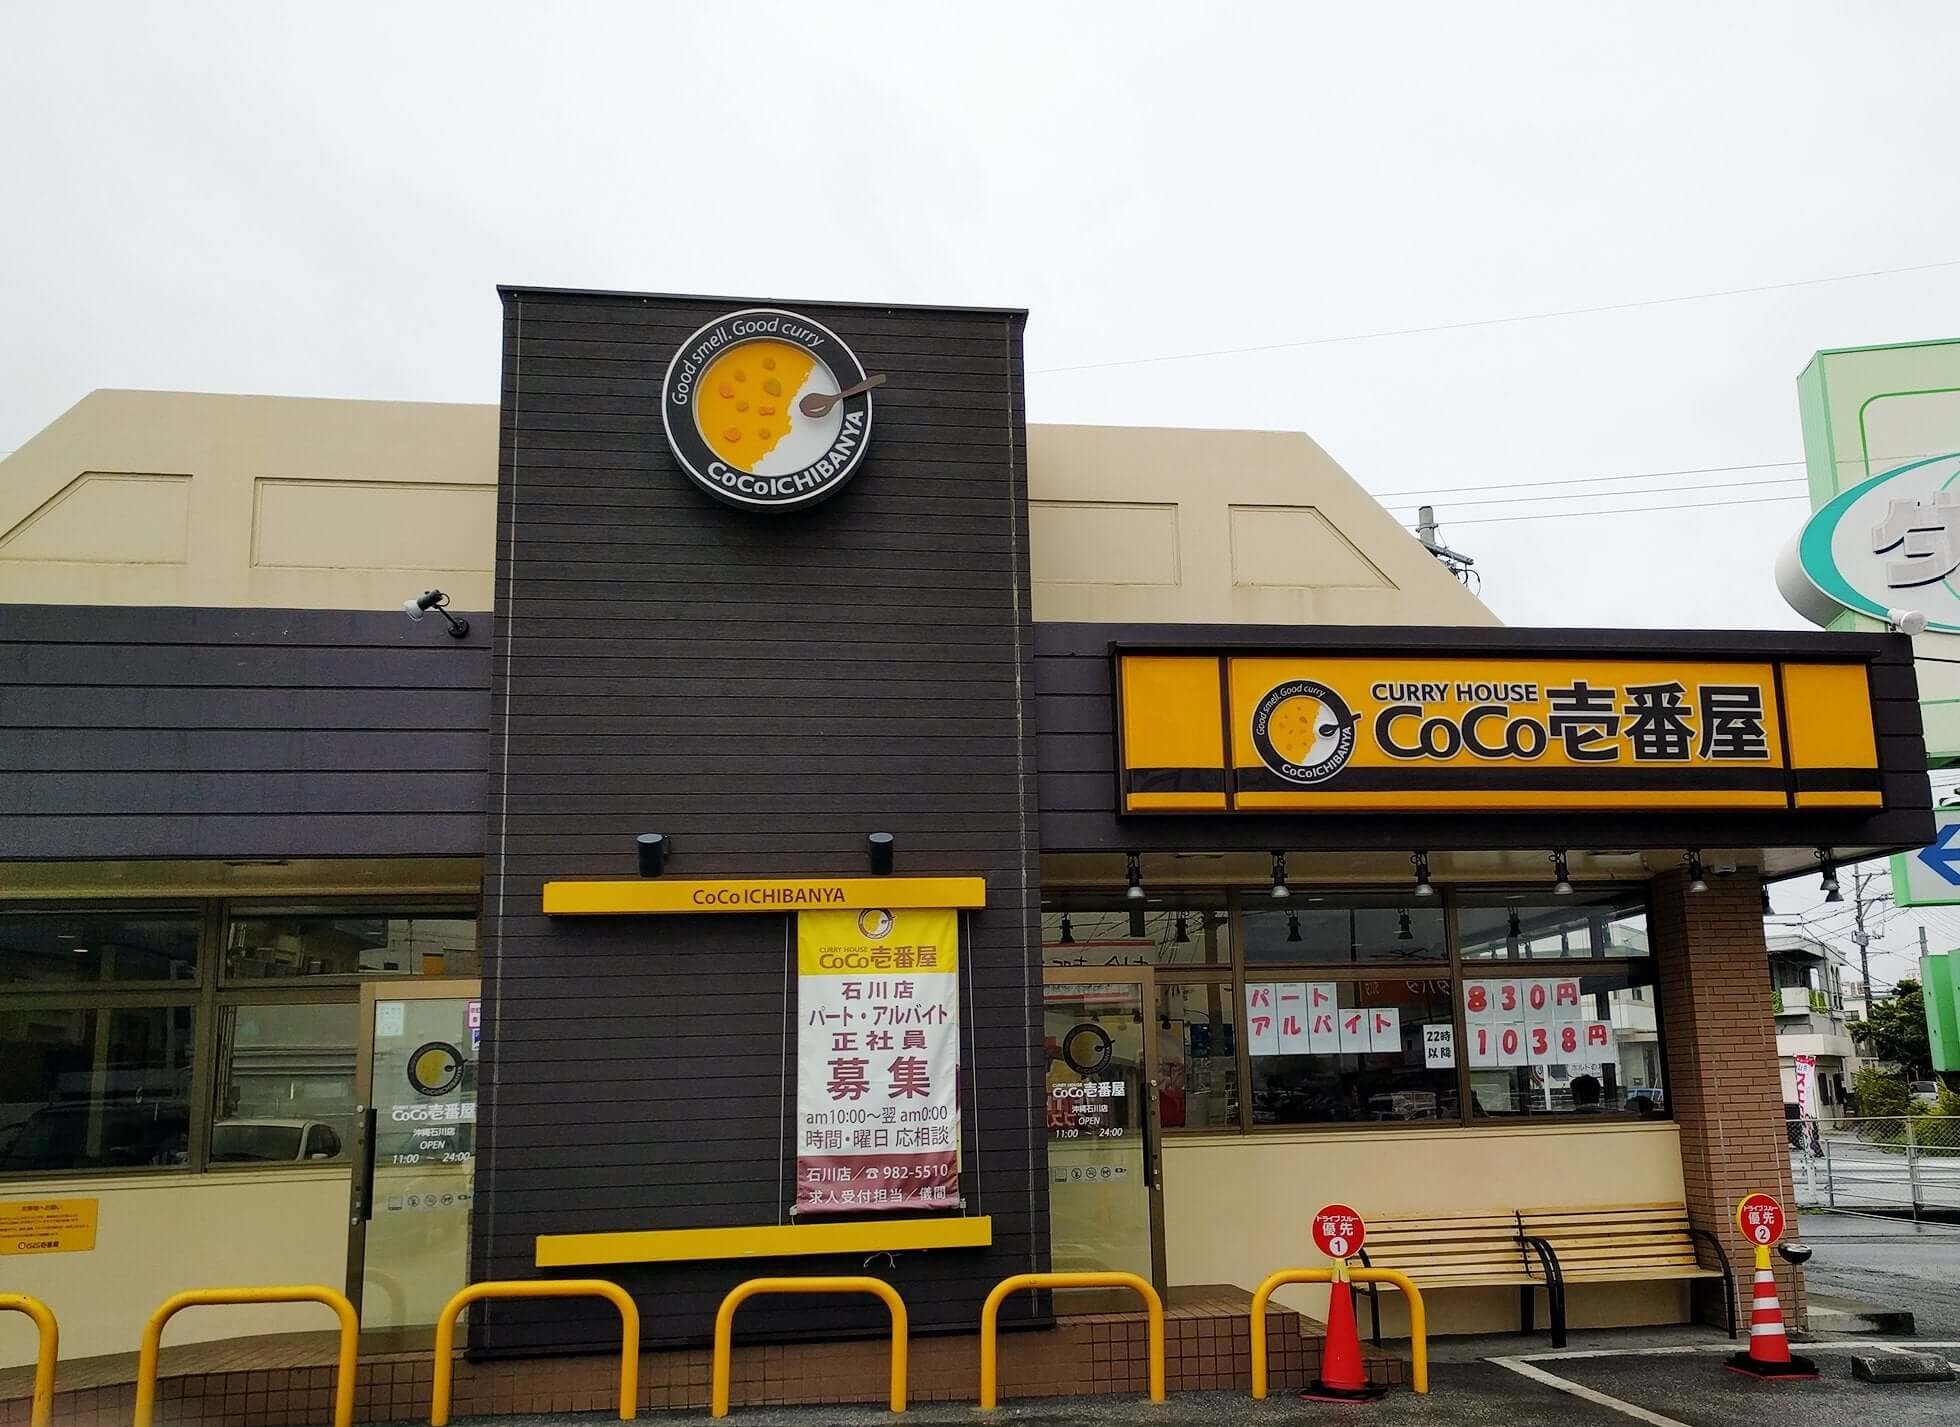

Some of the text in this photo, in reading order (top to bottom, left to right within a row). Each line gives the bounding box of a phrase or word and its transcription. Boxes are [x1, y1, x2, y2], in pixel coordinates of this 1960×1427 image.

[672, 318, 825, 405] Good smell. Good curry
[1372, 683, 1538, 702] CURRY HOUSE
[1257, 712, 1266, 736] Good
[1280, 684, 1302, 698] Good
[1303, 685, 1326, 699] curry
[1251, 987, 1329, 1008] パート
[1467, 982, 1578, 1013] 830円
[1252, 1013, 1392, 1036] アルバイト
[832, 1030, 928, 1051] 正社員
[1426, 1031, 1451, 1043] 22時
[1478, 1024, 1608, 1056] 1038円
[826, 1056, 931, 1101] 募集
[1078, 1116, 1101, 1125] OPEN
[1056, 1129, 1079, 1138] 11:00
[1099, 1127, 1124, 1137] 24:00
[420, 1140, 446, 1150] OPEN
[393, 1154, 420, 1164] 11:00
[442, 1152, 471, 1162] 24:00
[883, 1164, 948, 1179] 982-5510
